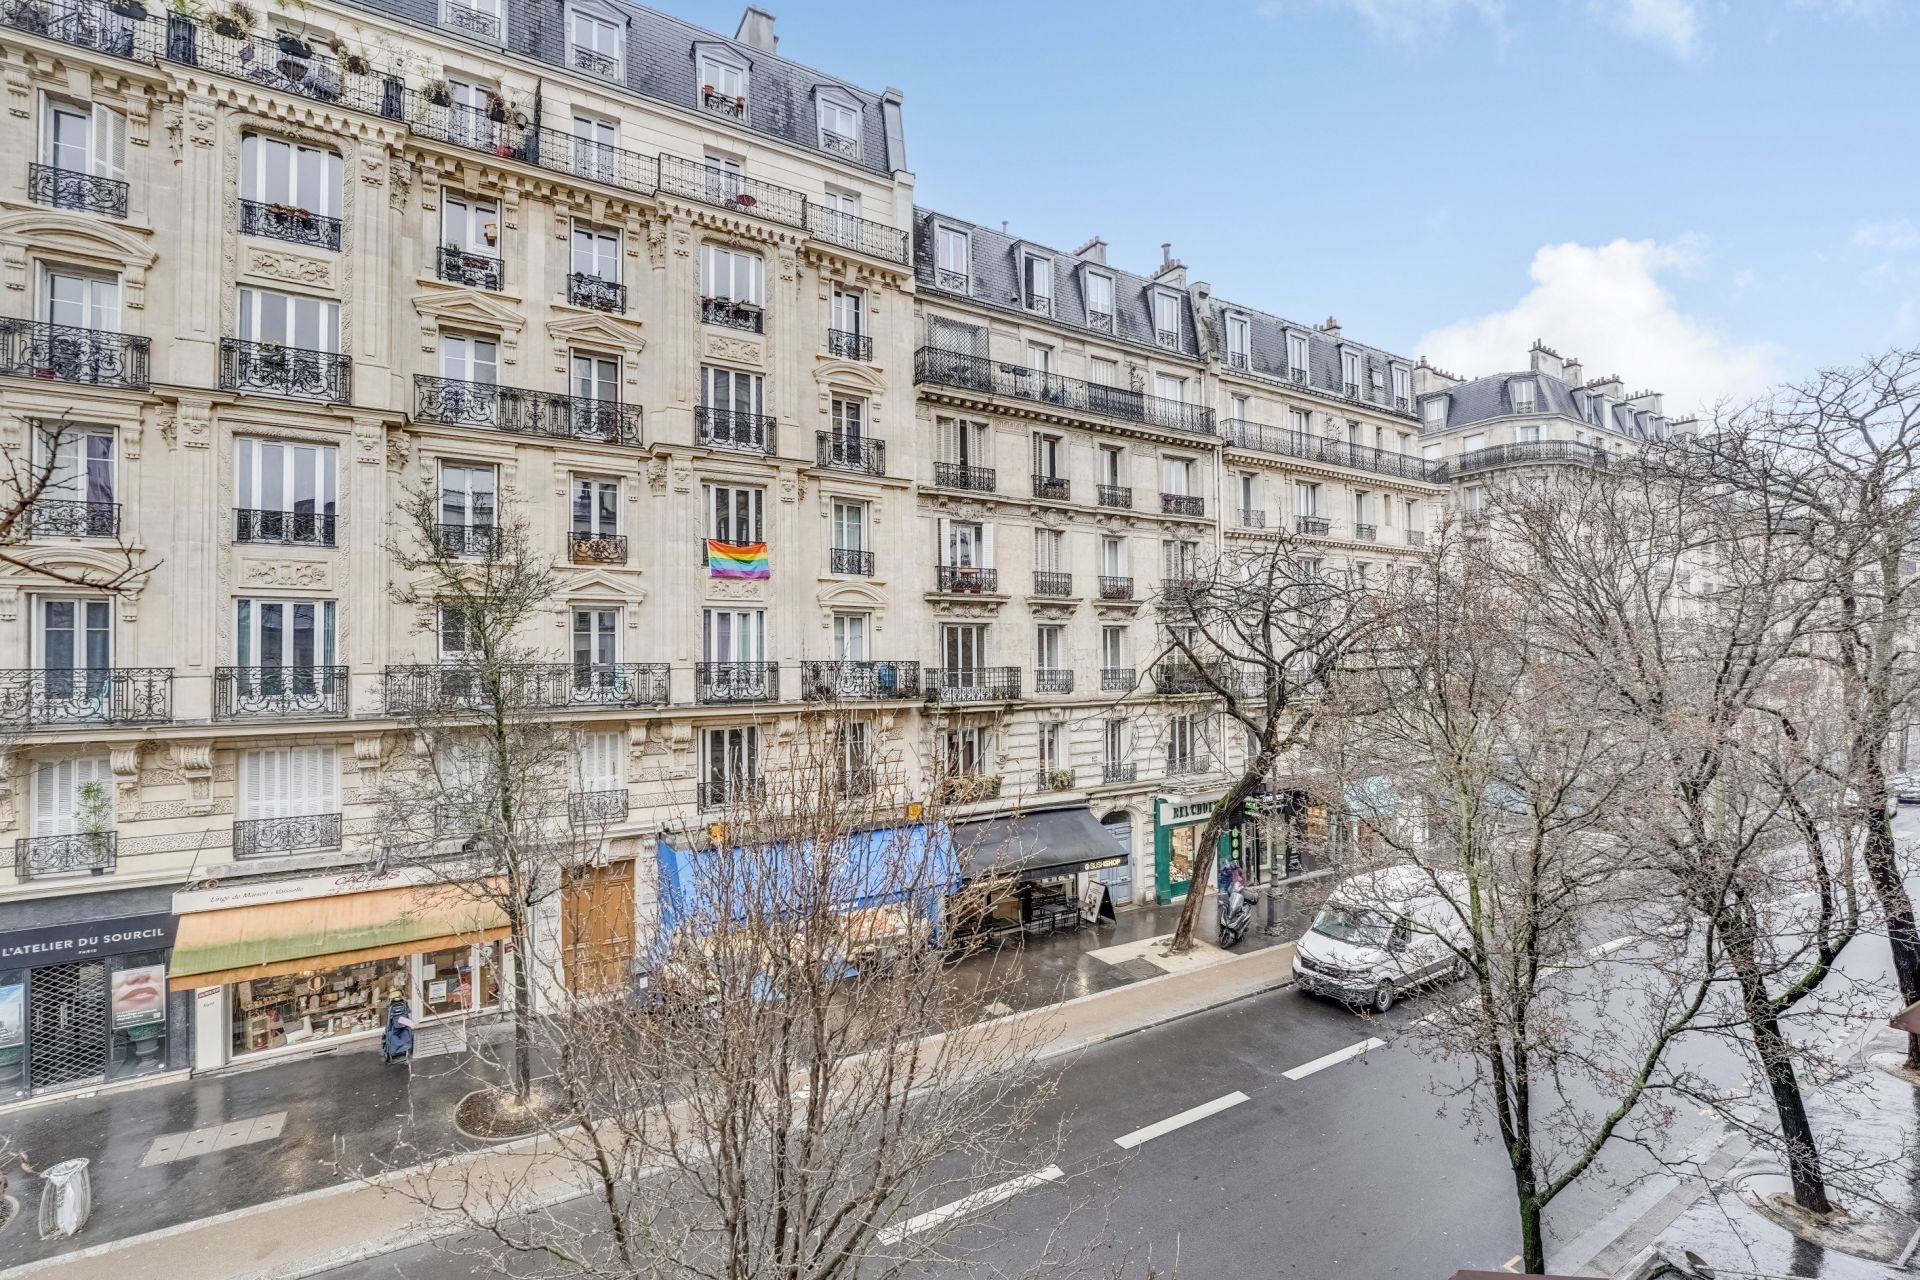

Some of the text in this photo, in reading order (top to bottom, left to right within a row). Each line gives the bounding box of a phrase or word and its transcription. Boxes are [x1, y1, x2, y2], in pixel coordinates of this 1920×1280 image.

[242, 890, 268, 899] Maison
[2, 928, 165, 957] L'ATELIER DU SOURCIL
